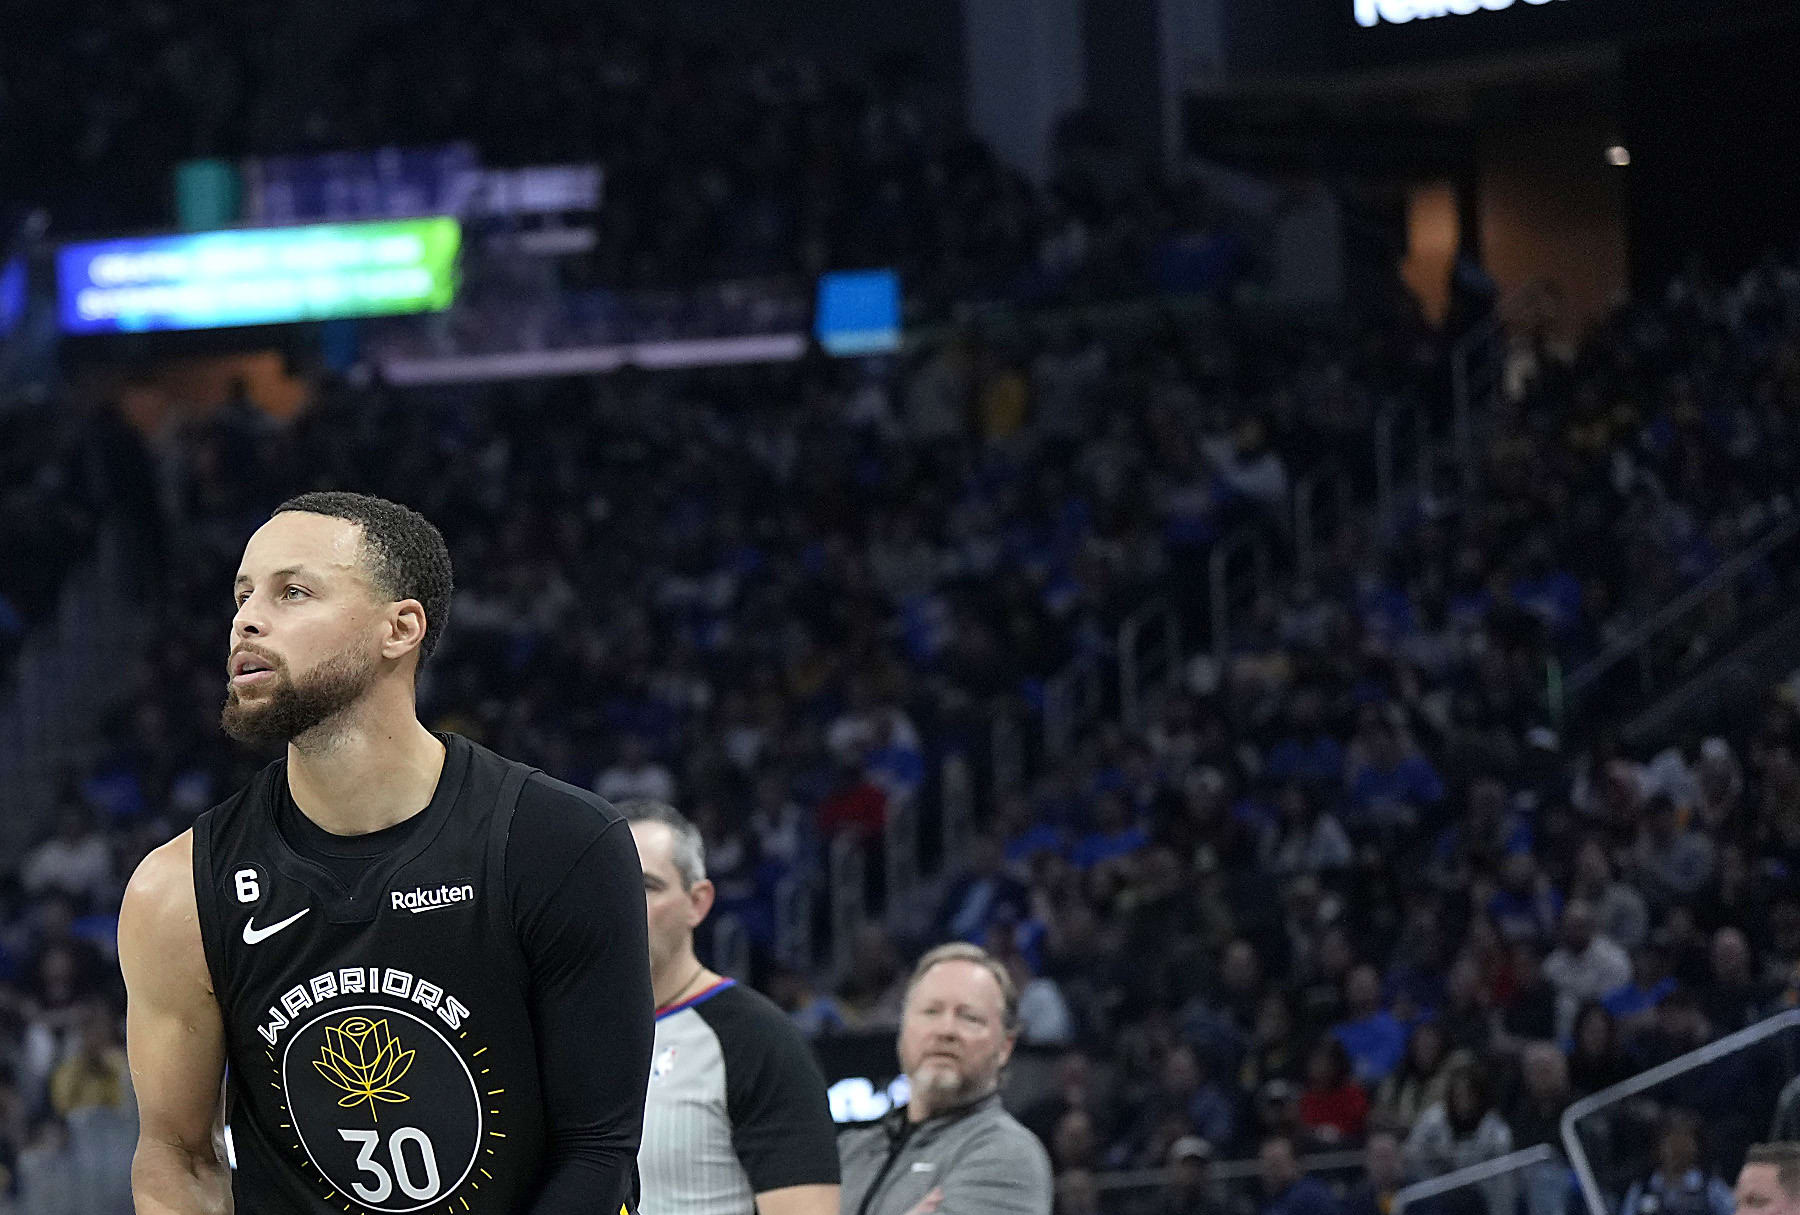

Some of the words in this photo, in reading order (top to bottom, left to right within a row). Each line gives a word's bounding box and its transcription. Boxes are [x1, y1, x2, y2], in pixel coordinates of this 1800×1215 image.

[234, 868, 260, 903] 6
[390, 884, 475, 911] Rakuten
[256, 967, 471, 1047] WARRIORS
[338, 1126, 441, 1203] 30
